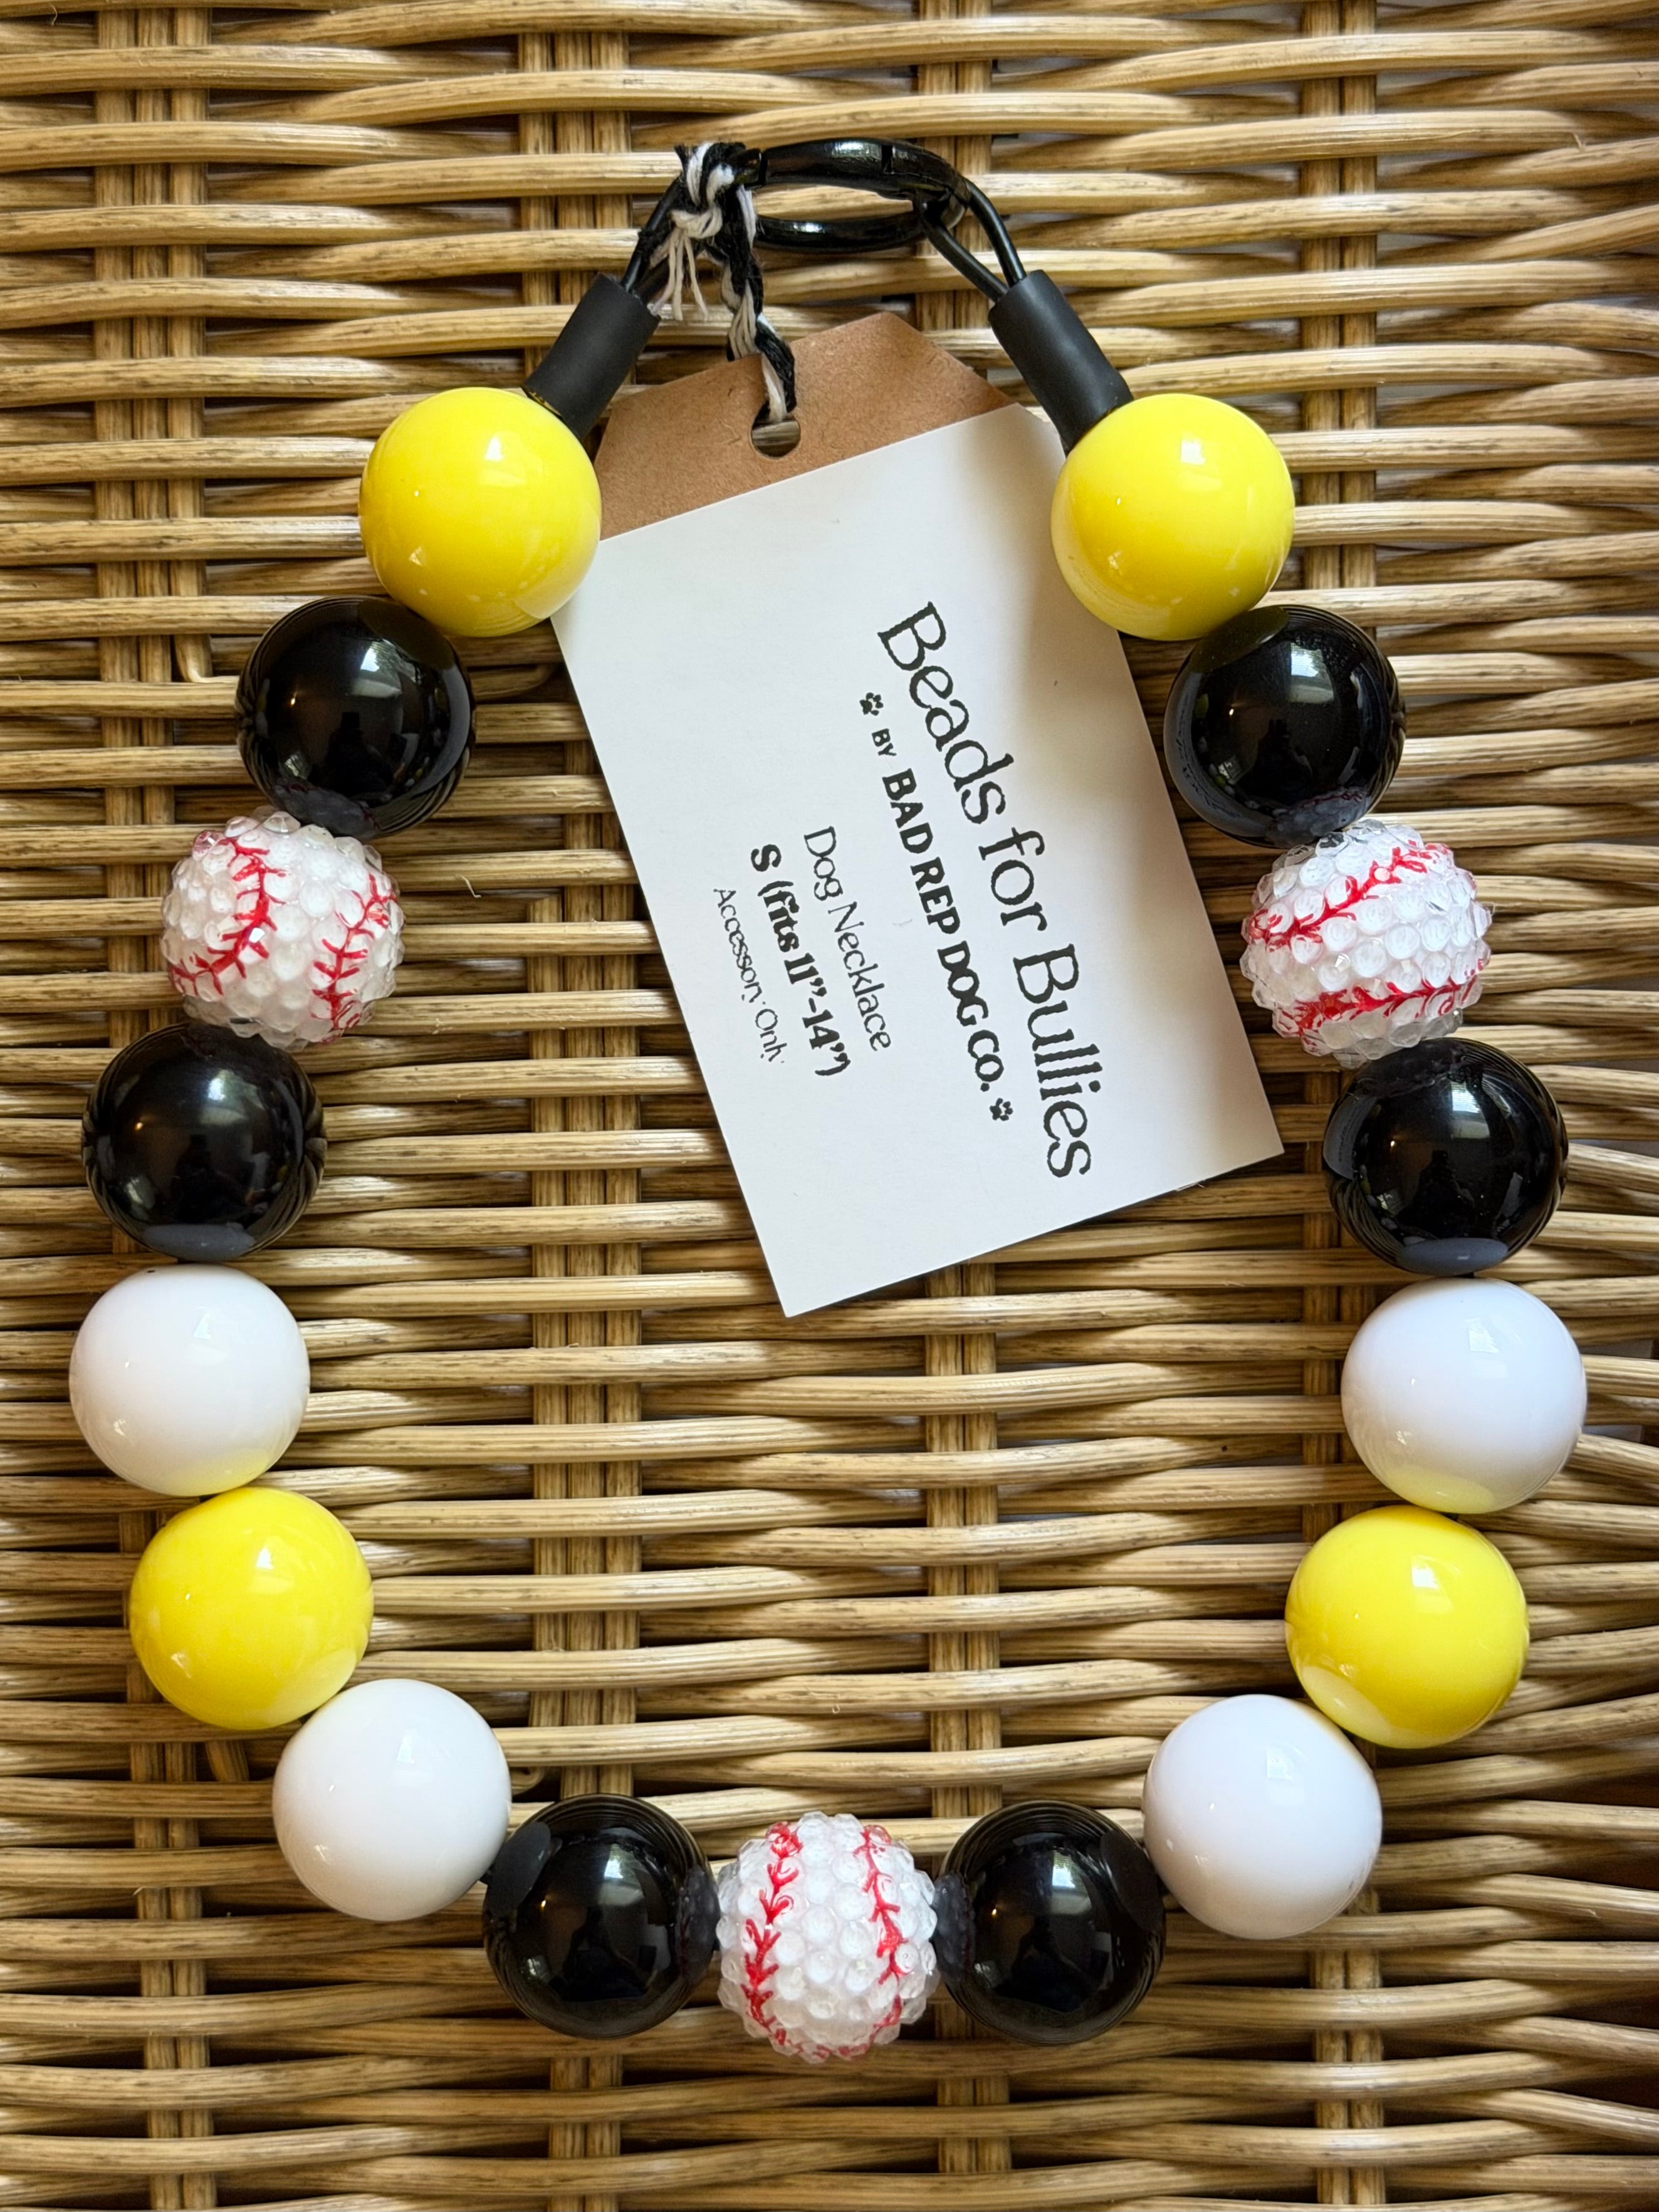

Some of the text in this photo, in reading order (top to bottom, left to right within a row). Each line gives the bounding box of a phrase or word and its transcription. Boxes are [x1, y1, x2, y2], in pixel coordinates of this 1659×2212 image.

[751, 844, 782, 873] S
[757, 881, 800, 953] (fits
[803, 826, 892, 1052] Dog Necklace
[872, 728, 1005, 1093] BY BAD REP DOG CO.
[877, 601, 1103, 1178] Beads for Bullies
